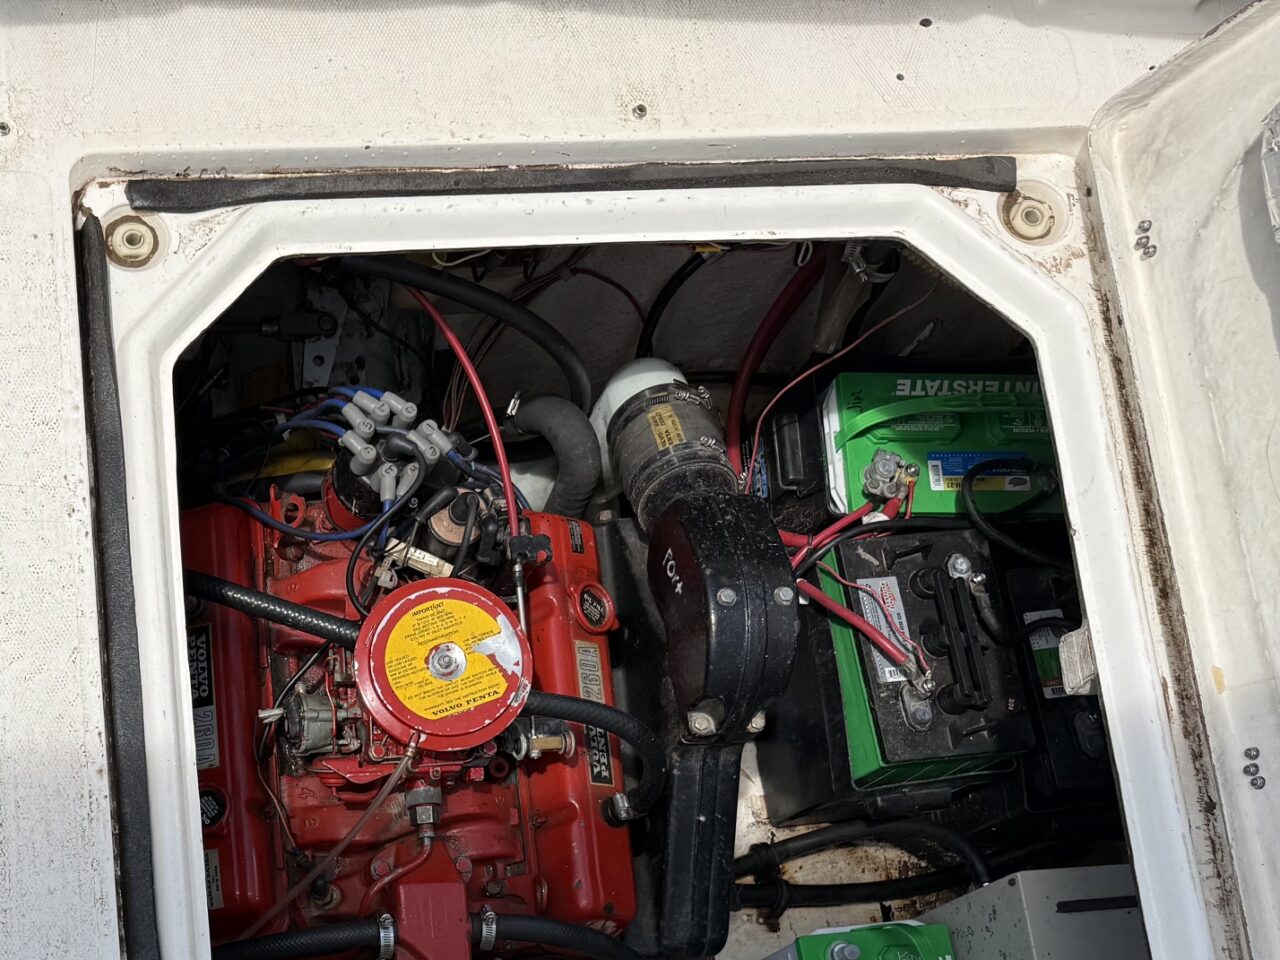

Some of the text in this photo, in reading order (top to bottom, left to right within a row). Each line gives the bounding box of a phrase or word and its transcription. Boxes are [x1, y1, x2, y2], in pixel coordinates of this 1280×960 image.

[411, 602, 444, 616] IMPORTANT
[196, 633, 208, 696] VOLVO
[578, 646, 601, 701] 260A
[431, 689, 499, 716] VOLVO PENTA
[588, 725, 600, 773] VOLV
[595, 727, 609, 779] PENT
